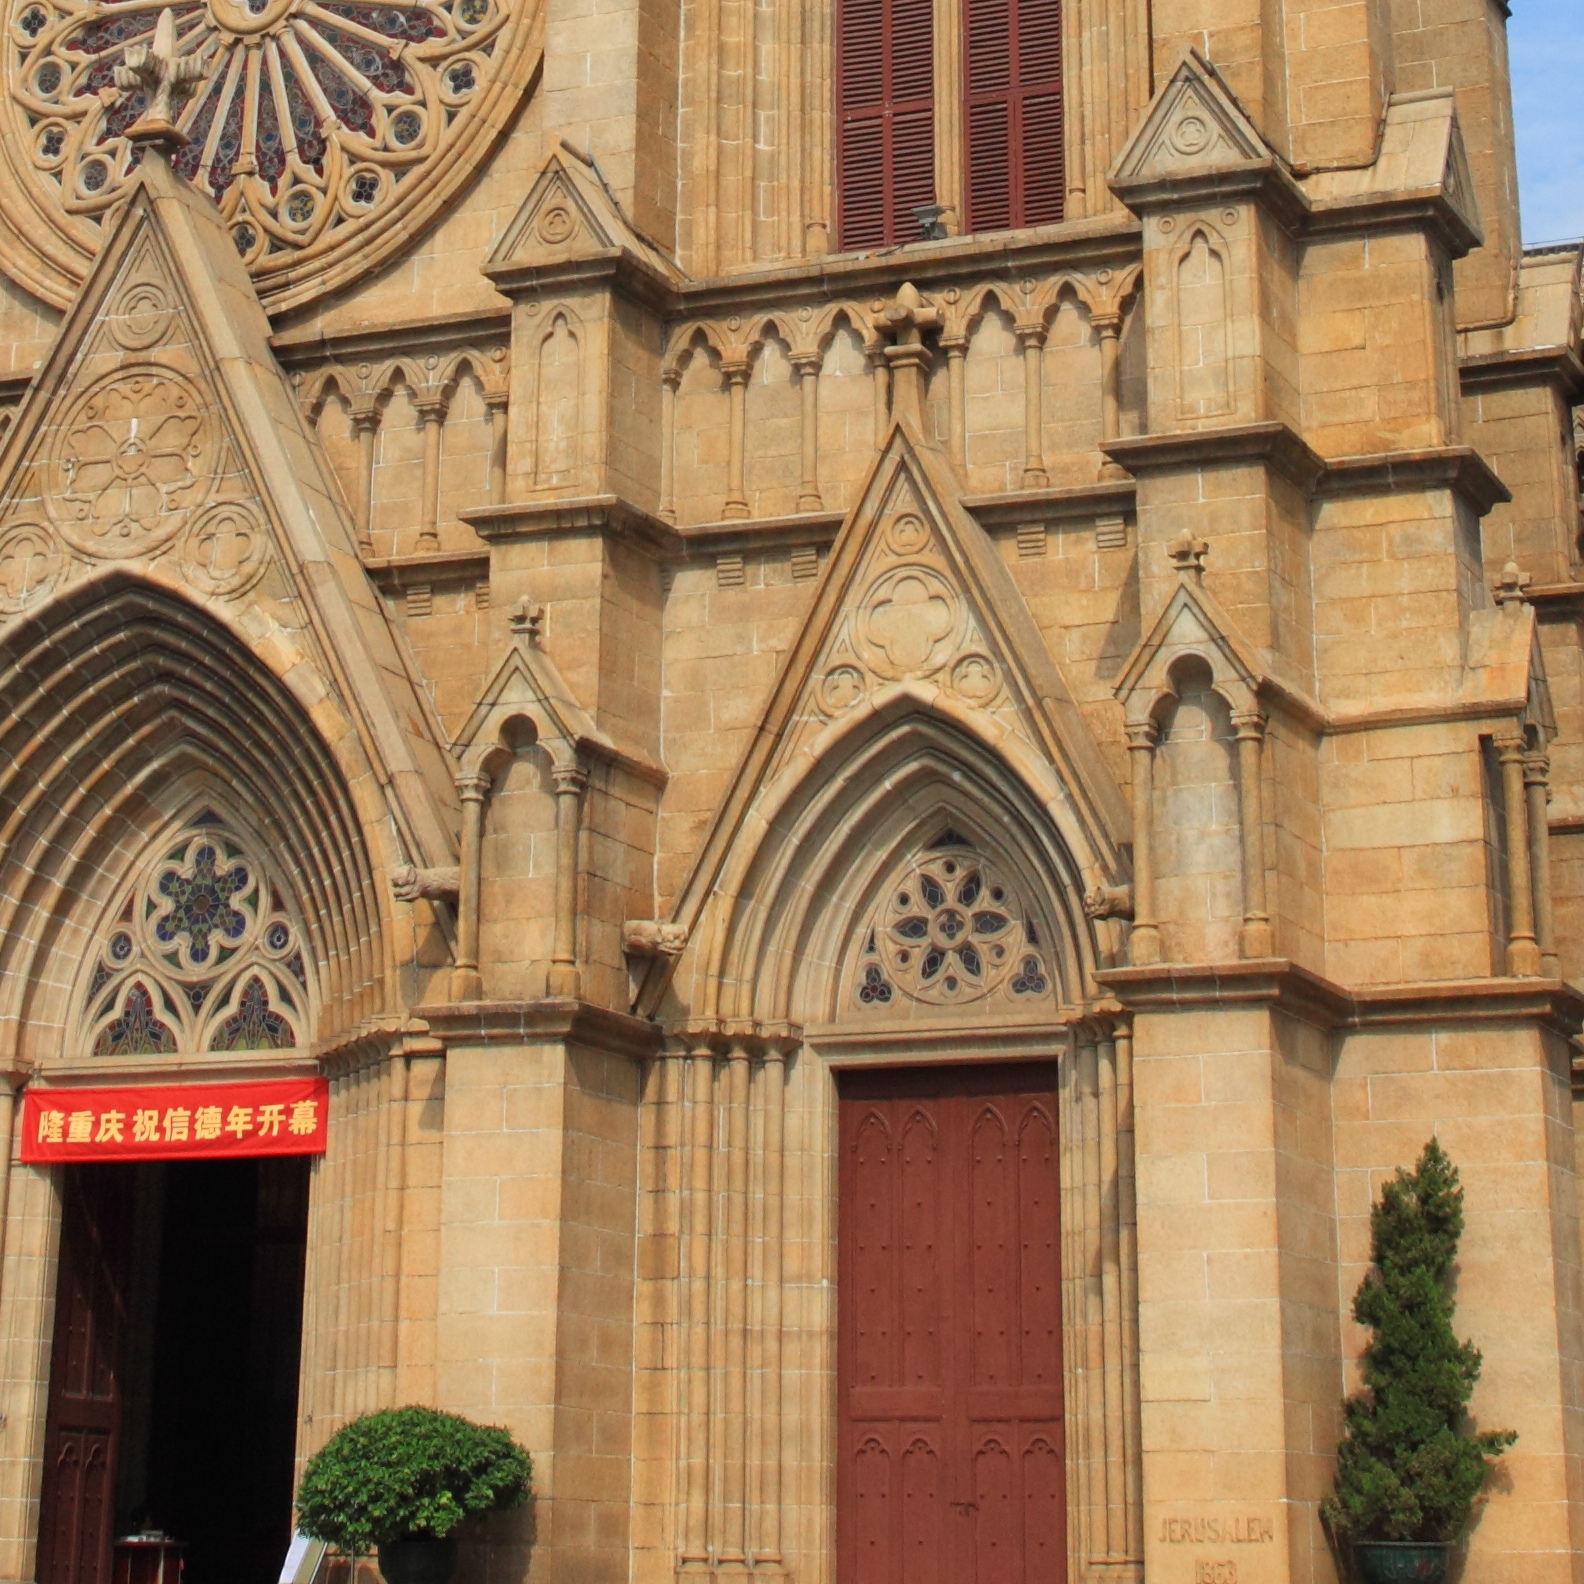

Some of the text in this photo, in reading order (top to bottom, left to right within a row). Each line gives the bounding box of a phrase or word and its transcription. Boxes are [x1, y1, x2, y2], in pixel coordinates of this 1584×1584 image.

[37, 1100, 319, 1143] 隆重庆祝信德年开幕
[1157, 1516, 1273, 1544] JERUSALEM
